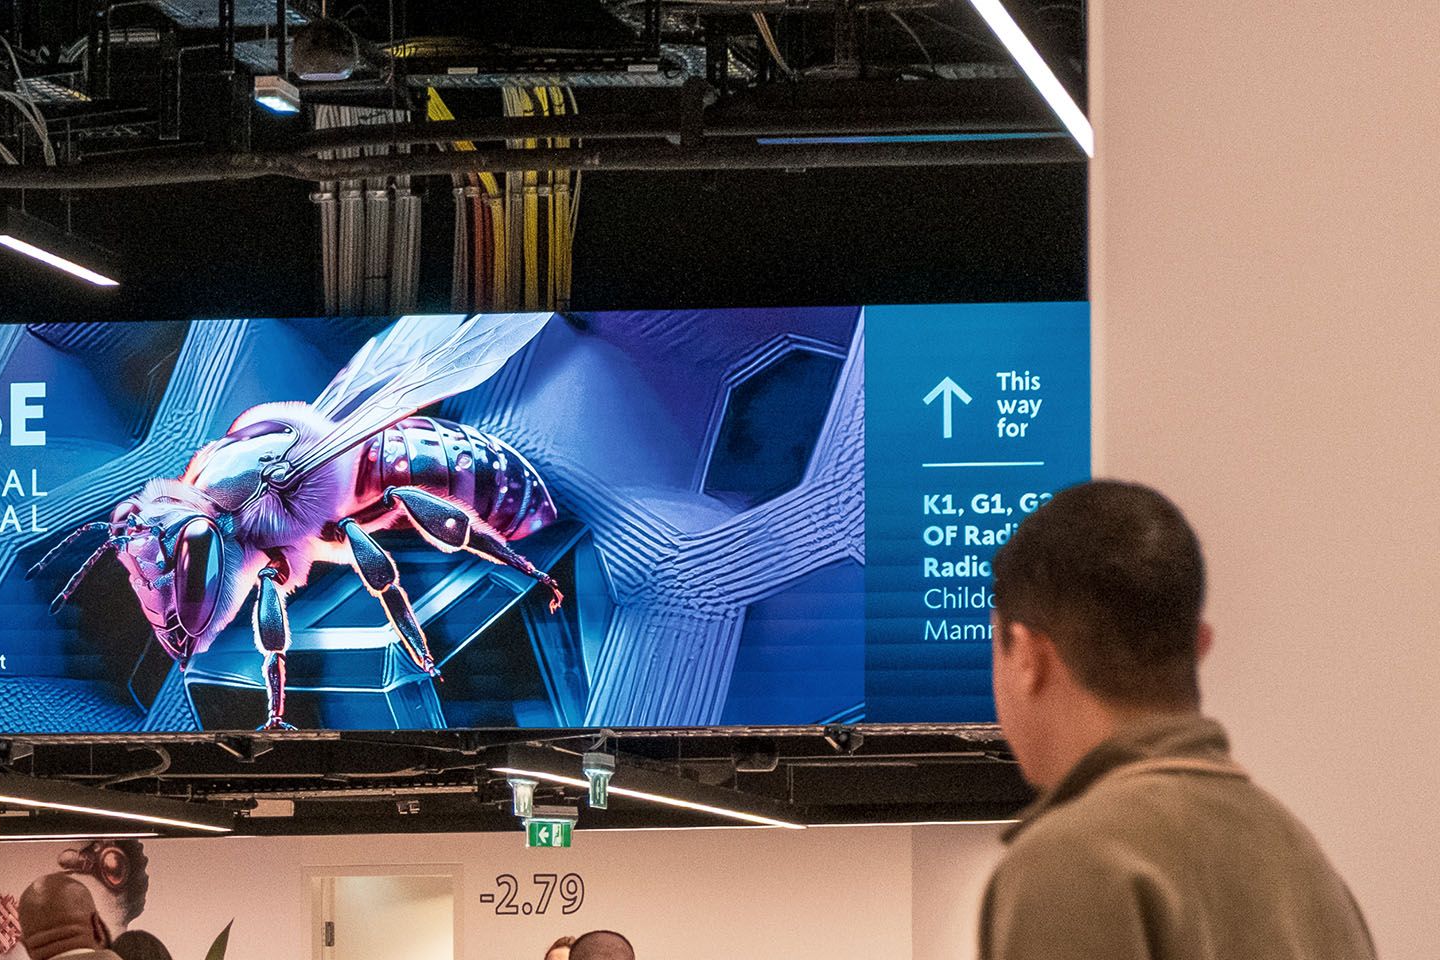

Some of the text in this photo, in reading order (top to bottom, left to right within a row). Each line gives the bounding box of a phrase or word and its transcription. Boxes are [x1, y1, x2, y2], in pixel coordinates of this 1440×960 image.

[996, 370, 1041, 391] This
[996, 399, 1043, 419] way
[996, 416, 1029, 438] for
[923, 494, 965, 517] K1,
[971, 493, 1013, 516] G1,
[923, 525, 959, 546] OF
[480, 873, 585, 915] -2.79
